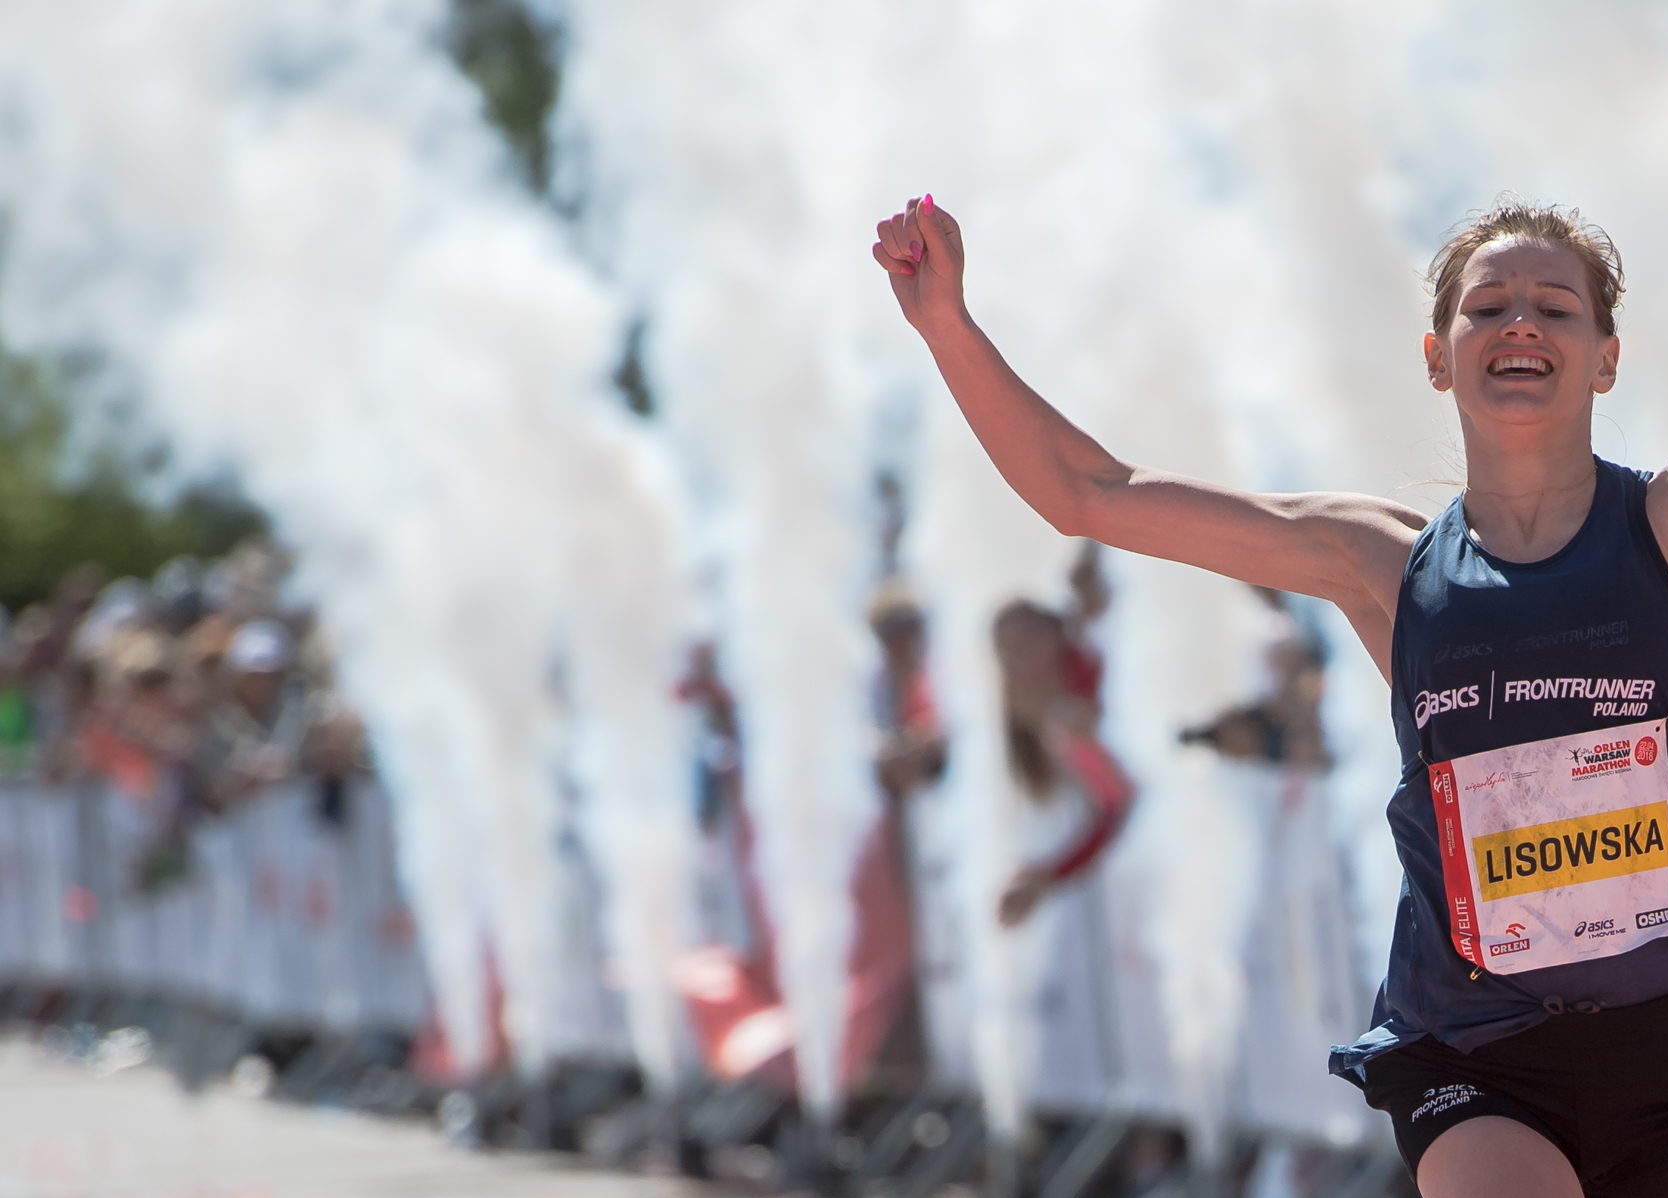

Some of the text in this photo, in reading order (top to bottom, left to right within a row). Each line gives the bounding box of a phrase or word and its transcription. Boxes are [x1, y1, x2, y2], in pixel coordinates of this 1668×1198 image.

[1505, 678, 1656, 703] FRONTRUNNER
[1592, 701, 1648, 717] POLAND
[1594, 740, 1631, 754] ORLEN
[1636, 750, 1654, 761] 2018
[1583, 749, 1632, 765] WARSAW
[1572, 758, 1631, 777] MARATHON
[1444, 775, 1452, 802] ORLEN
[1486, 818, 1665, 884] LISOWSKA
[1492, 940, 1528, 954] ORLEN
[1433, 1096, 1470, 1116] POLAND
